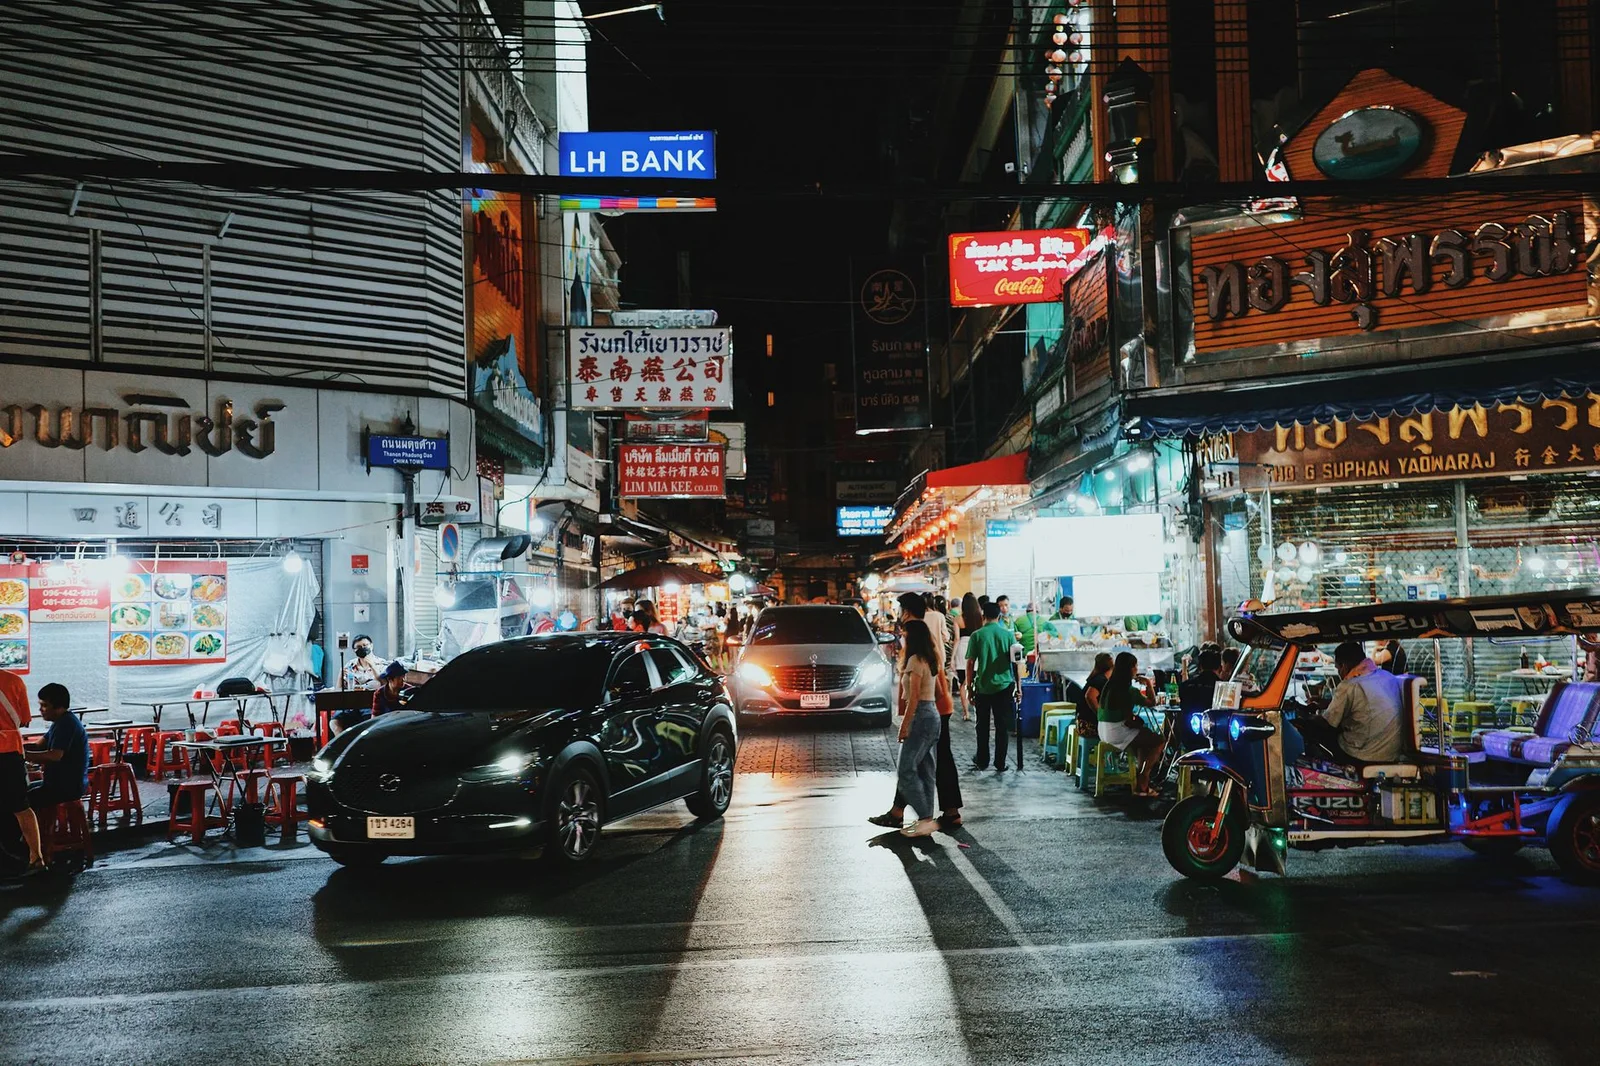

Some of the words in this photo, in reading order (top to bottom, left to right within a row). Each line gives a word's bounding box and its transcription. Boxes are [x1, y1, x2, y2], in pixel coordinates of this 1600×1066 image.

[570, 150, 606, 173] LH
[621, 149, 706, 173] BANK
[1203, 208, 1577, 332] ทองสุพรรณ
[994, 276, 1044, 296] Coca-Cola
[578, 330, 724, 353] รังนกใต้เยาวราช
[575, 355, 726, 384] 泰南燕公司
[381, 438, 437, 452] ถนนผดุงด้าว
[402, 451, 423, 459] Phadung
[625, 448, 653, 464] บริษัท
[694, 448, 719, 463] จำกัด
[1323, 460, 1389, 480] SUPHAN
[1398, 450, 1496, 474] YAOWARAJ
[624, 481, 645, 493] LIM
[648, 480, 668, 493] MIA
[671, 480, 693, 493] KEE
[72, 501, 223, 530] 四通公司
[1339, 615, 1430, 636] ISUZU
[389, 818, 412, 829] 4264
